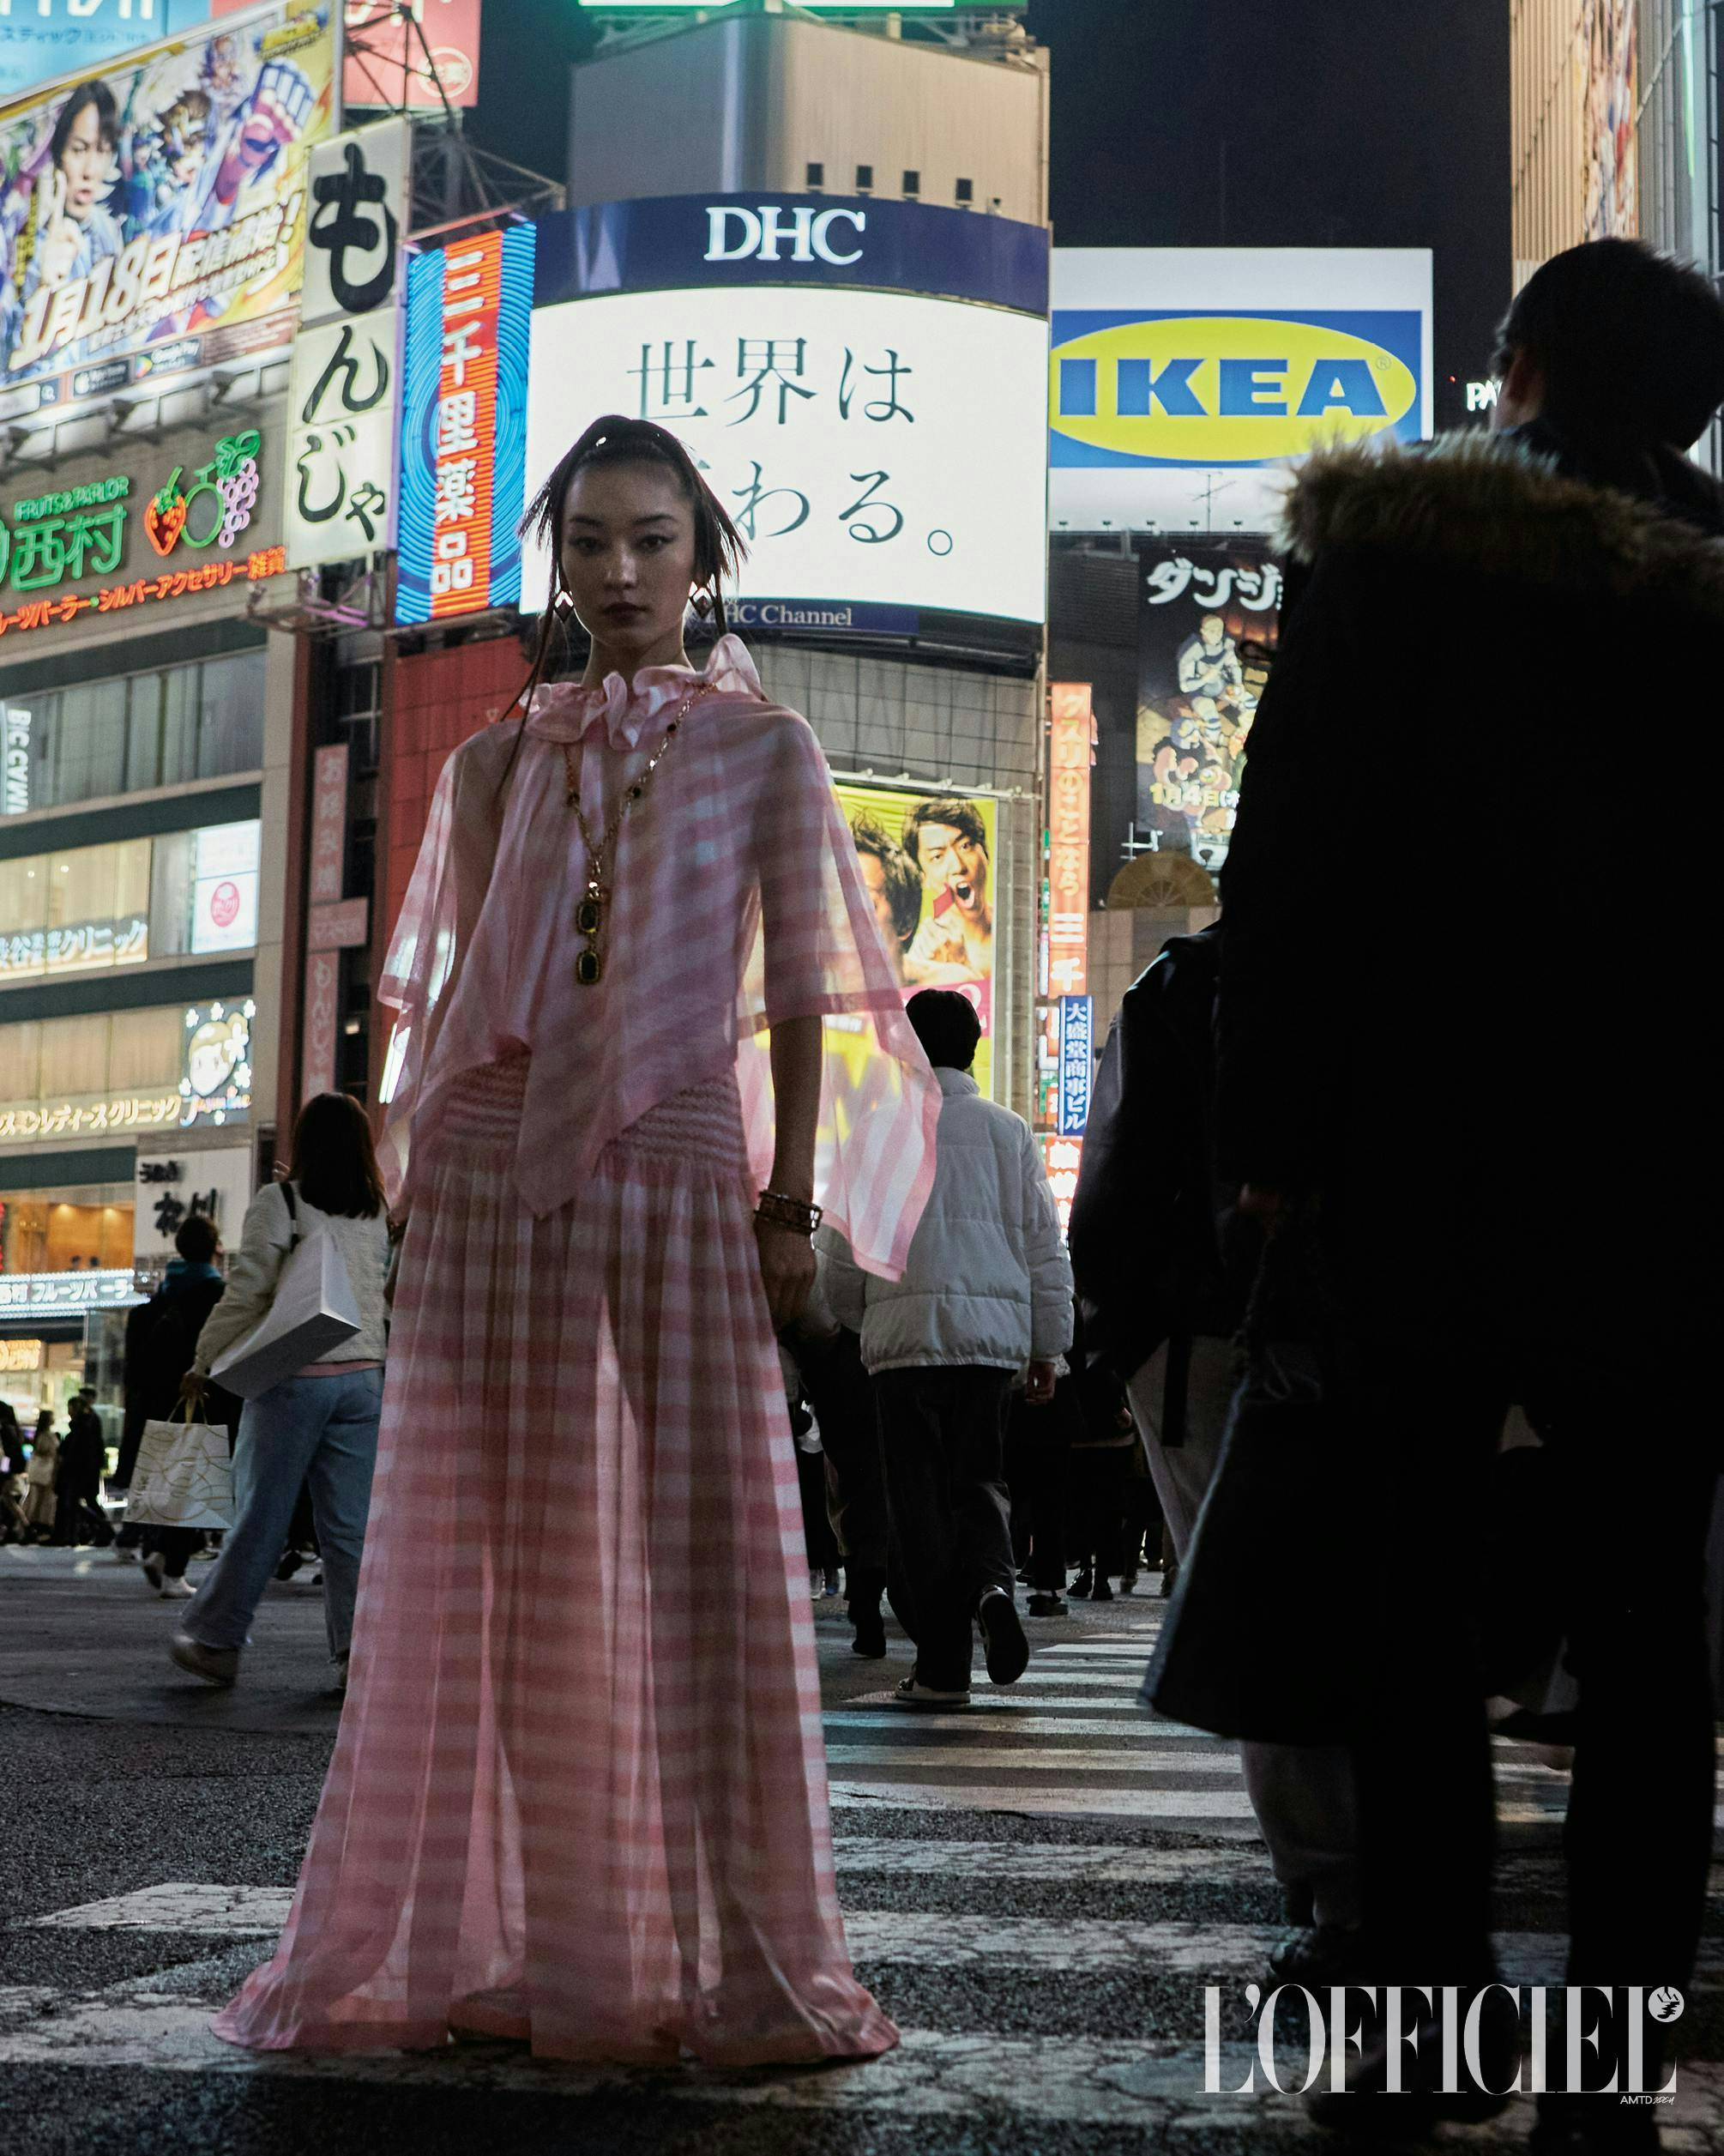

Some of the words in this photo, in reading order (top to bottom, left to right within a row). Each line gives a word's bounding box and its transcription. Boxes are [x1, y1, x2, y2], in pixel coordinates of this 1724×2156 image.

[703, 207, 865, 265] DHC
[298, 142, 397, 542] もんじゃ
[626, 337, 914, 426] 世界は
[429, 250, 485, 594] 三千里薬品
[1060, 359, 1389, 416] IKEA
[10, 503, 128, 591] 西村
[696, 460, 953, 556] わる。
[761, 605, 853, 626] Channel
